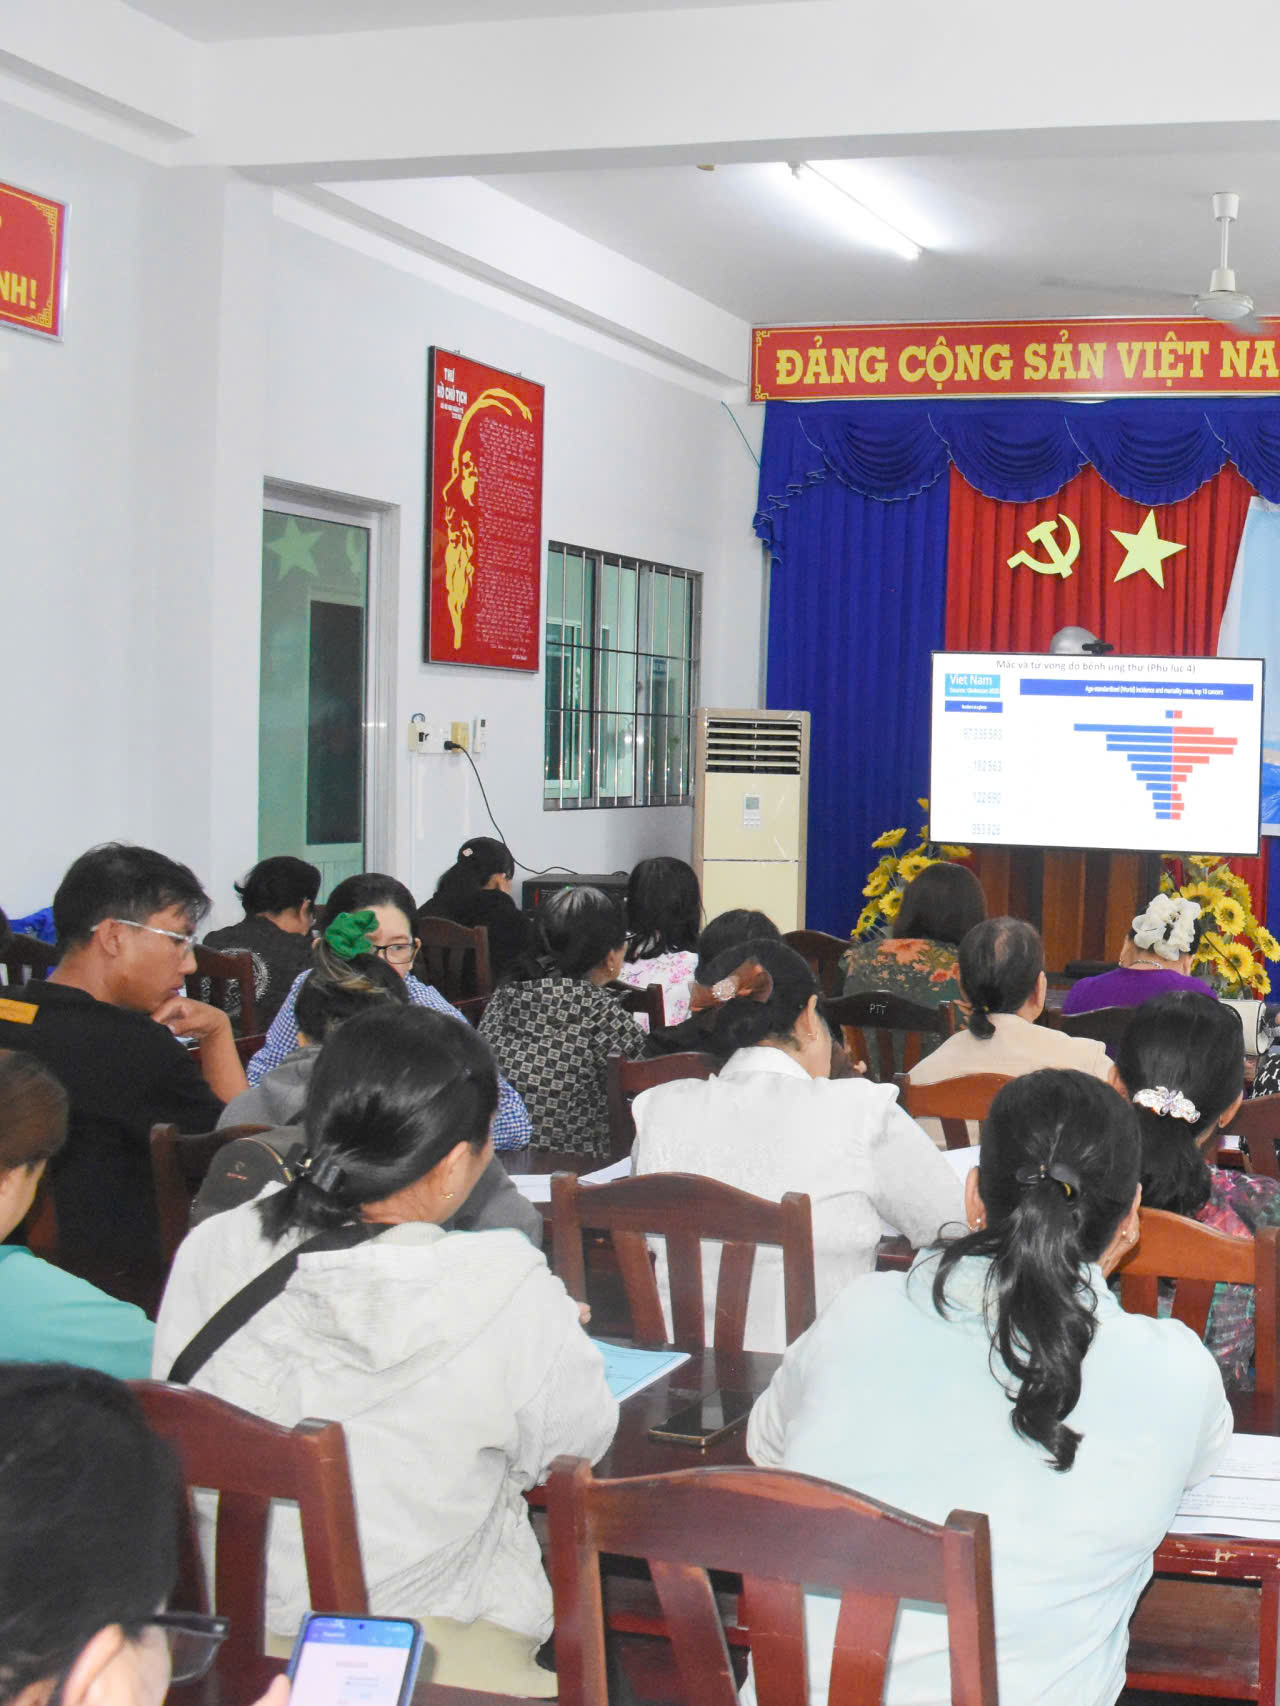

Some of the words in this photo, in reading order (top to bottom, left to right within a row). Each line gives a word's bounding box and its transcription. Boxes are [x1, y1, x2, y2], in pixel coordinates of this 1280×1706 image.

[776, 335, 888, 384] ĐẢNG
[898, 337, 1013, 390] CỘNG
[1024, 330, 1107, 380] SẢN
[1117, 331, 1210, 386] VIỆT
